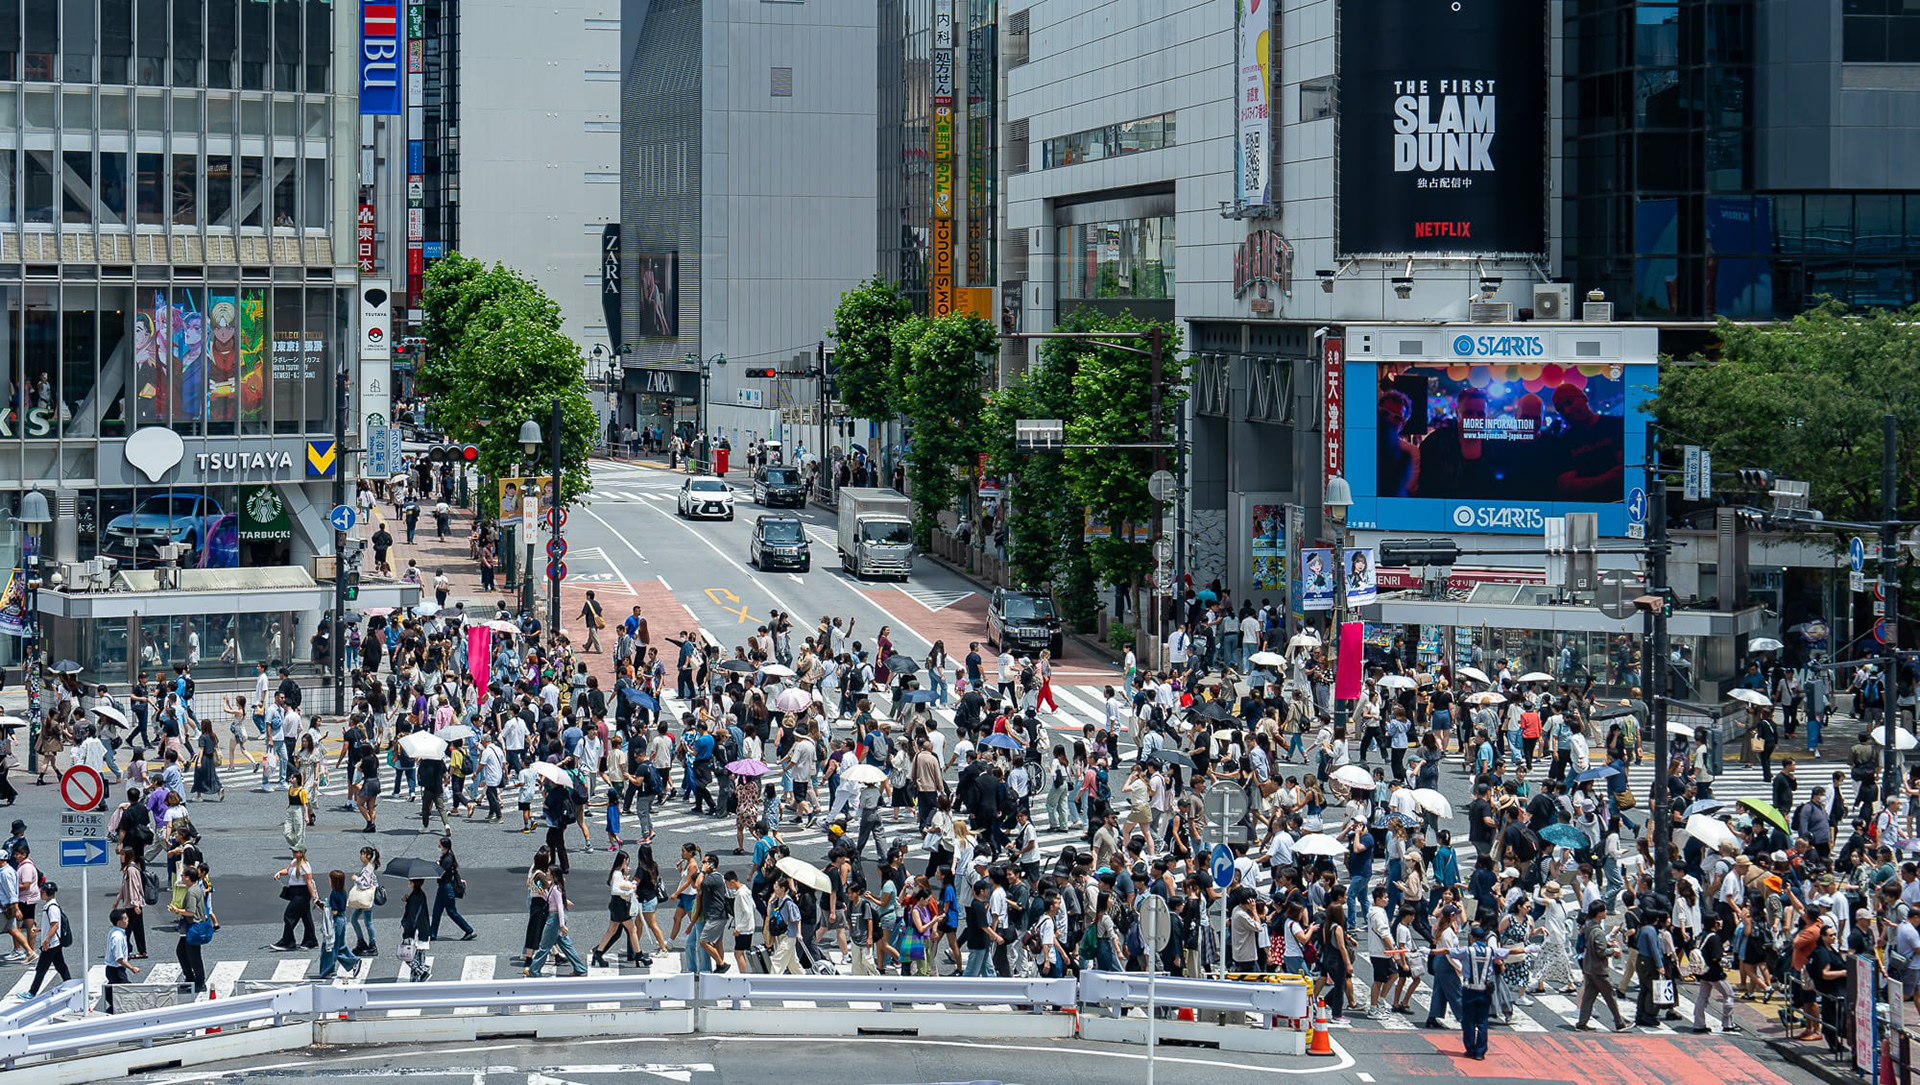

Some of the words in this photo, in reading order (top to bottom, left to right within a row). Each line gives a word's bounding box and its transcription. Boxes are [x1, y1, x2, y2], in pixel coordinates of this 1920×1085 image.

[937, 13, 950, 44] 内科
[364, 0, 396, 90] IBU
[936, 52, 951, 94] 処方せん
[1394, 81, 1428, 94] THE
[1440, 80, 1495, 94] FIRST
[1393, 95, 1496, 134] SLAM
[1394, 133, 1496, 172] DUNK
[1417, 177, 1473, 189] 独占配信中
[1414, 221, 1471, 238] NETFLIX
[358, 228, 373, 272] 東日本
[937, 218, 949, 271] TOUCH
[604, 235, 619, 294] ZARA
[937, 277, 949, 319] OM'S
[1477, 336, 1544, 356] STARTS
[647, 370, 674, 393] ZARA
[1328, 371, 1338, 483] 天津甘
[1463, 417, 1484, 429] MORE
[1485, 418, 1534, 430] INFORMATION
[197, 451, 293, 471] TSUTAYA
[376, 430, 385, 472] 渋谷駅前
[1478, 508, 1544, 528] STARTS
[238, 531, 290, 541] STARBUCKS
[1375, 575, 1401, 585] ENRI
[68, 826, 96, 836] 6-22
